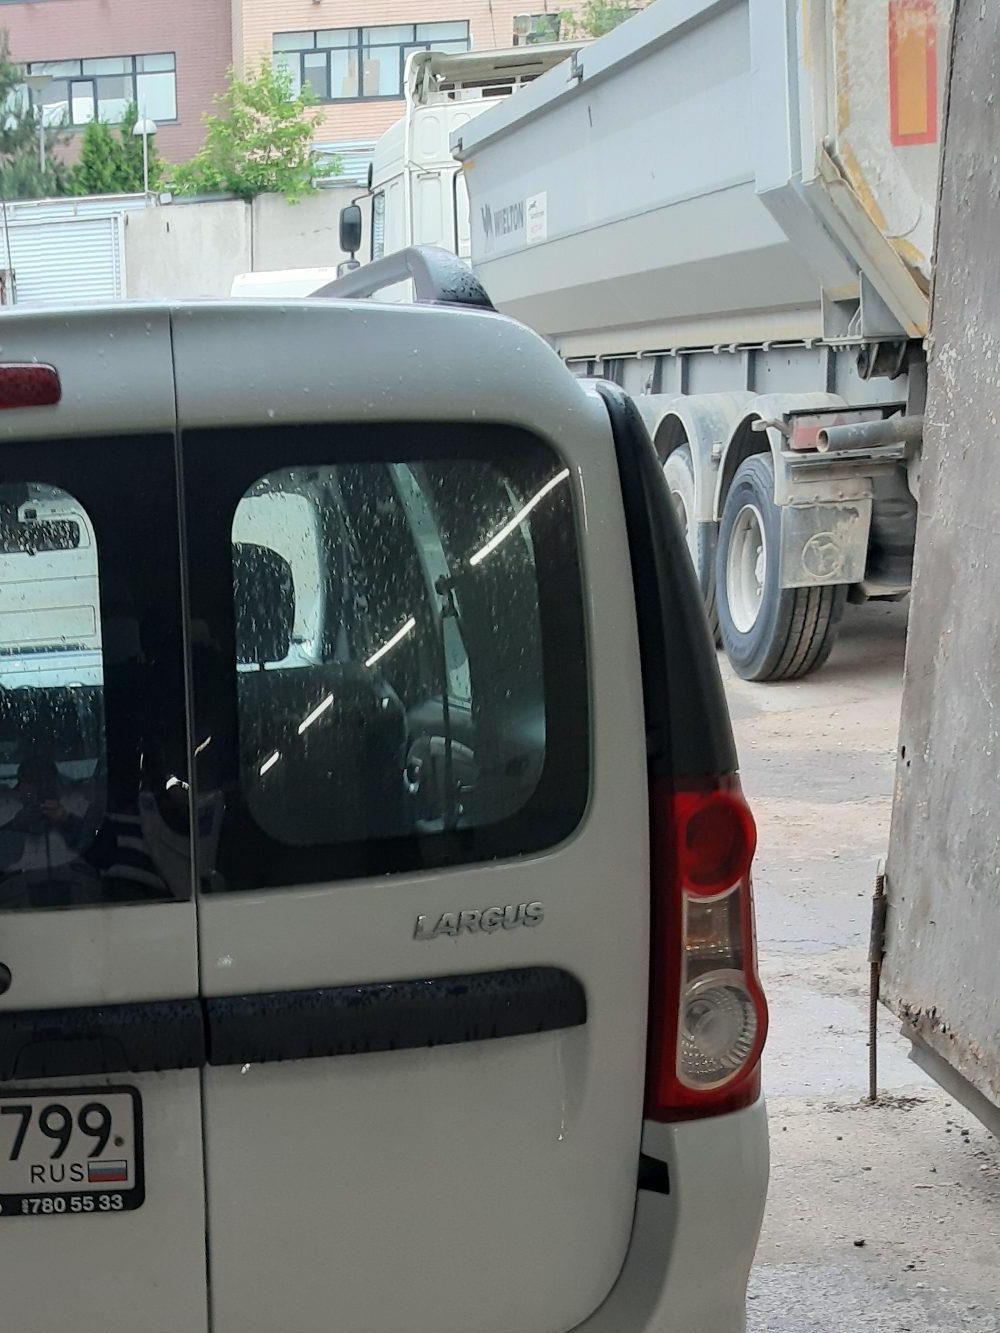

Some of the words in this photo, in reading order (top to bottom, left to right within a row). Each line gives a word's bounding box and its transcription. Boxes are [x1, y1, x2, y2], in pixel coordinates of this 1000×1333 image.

[413, 901, 544, 940] LARGUS
[1, 1103, 112, 1161] 799
[31, 1163, 85, 1184] RUS
[29, 1197, 66, 1214] 780
[70, 1195, 95, 1213] 55
[98, 1193, 124, 1211] 33
